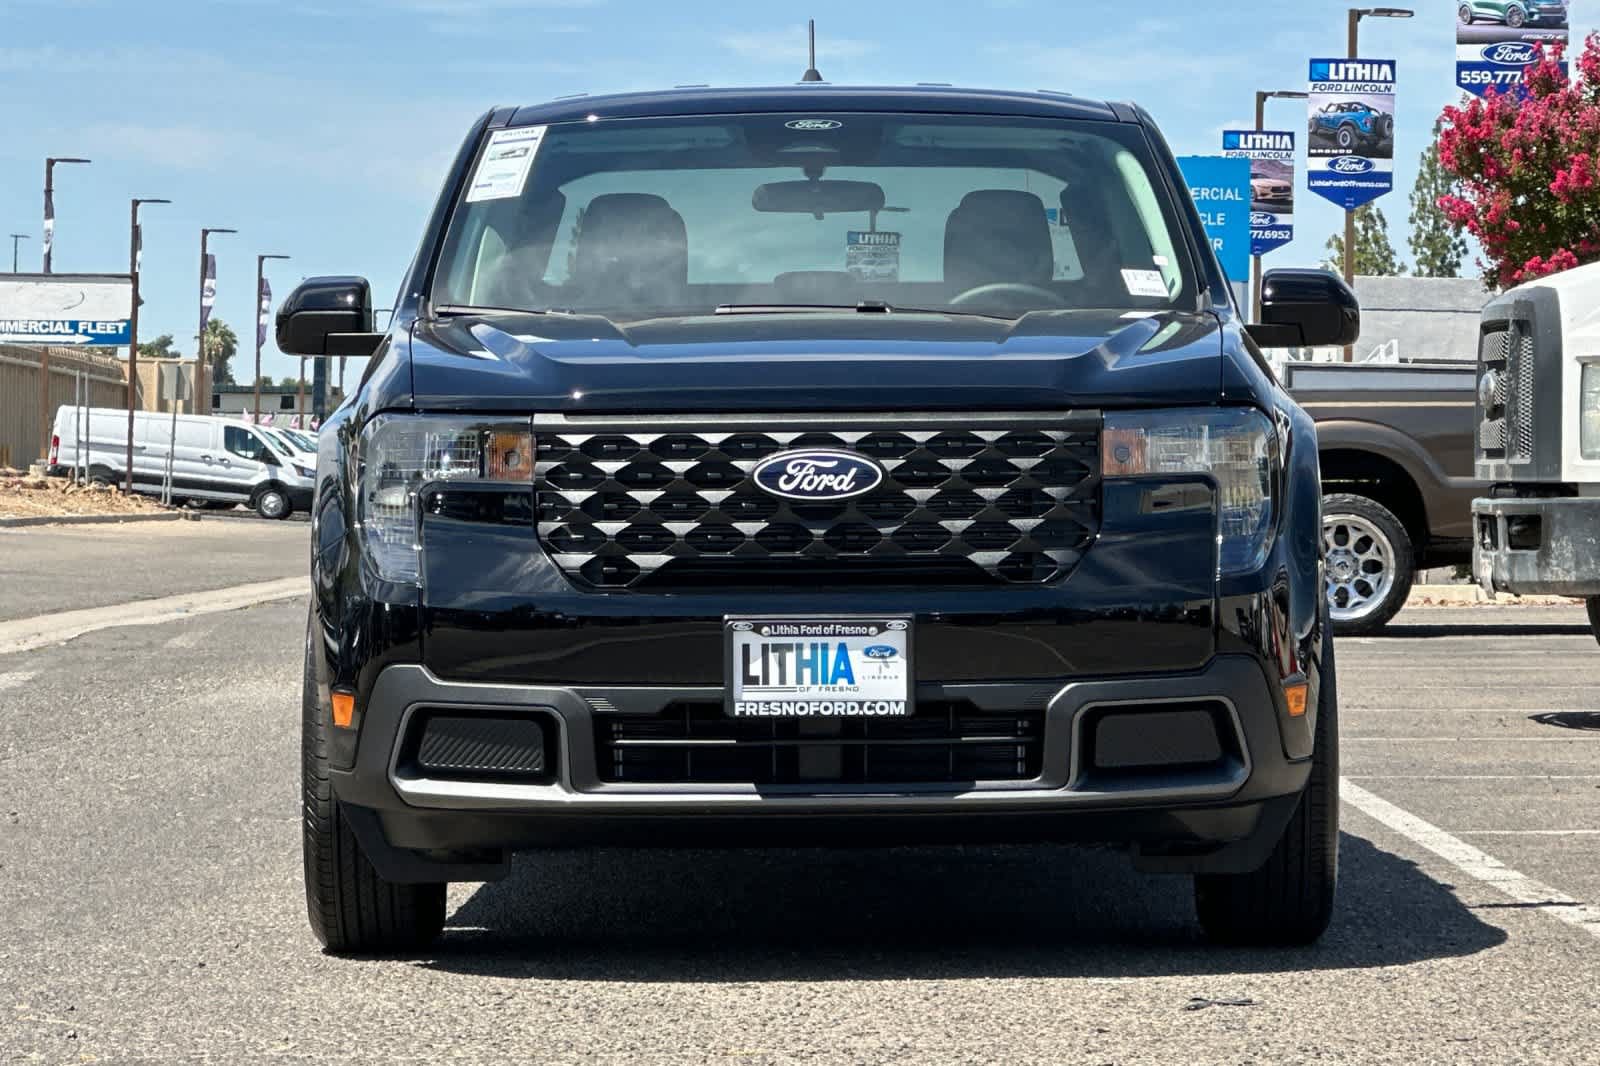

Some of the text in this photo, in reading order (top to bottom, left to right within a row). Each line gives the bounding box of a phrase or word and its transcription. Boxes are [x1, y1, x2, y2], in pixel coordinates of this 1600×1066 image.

[1494, 45, 1532, 60] Ford
[1329, 63, 1392, 80] LITHIA
[1344, 84, 1392, 92] LINCOLN
[1240, 135, 1292, 149] LITHIA
[1336, 158, 1366, 170] Ford
[78, 322, 127, 333] FLEET
[779, 459, 858, 491] Ford
[771, 625, 867, 635] Lithia Ford of Fresno
[742, 642, 855, 685] LITHIA
[735, 702, 905, 715] FRESNOFORD.COM
